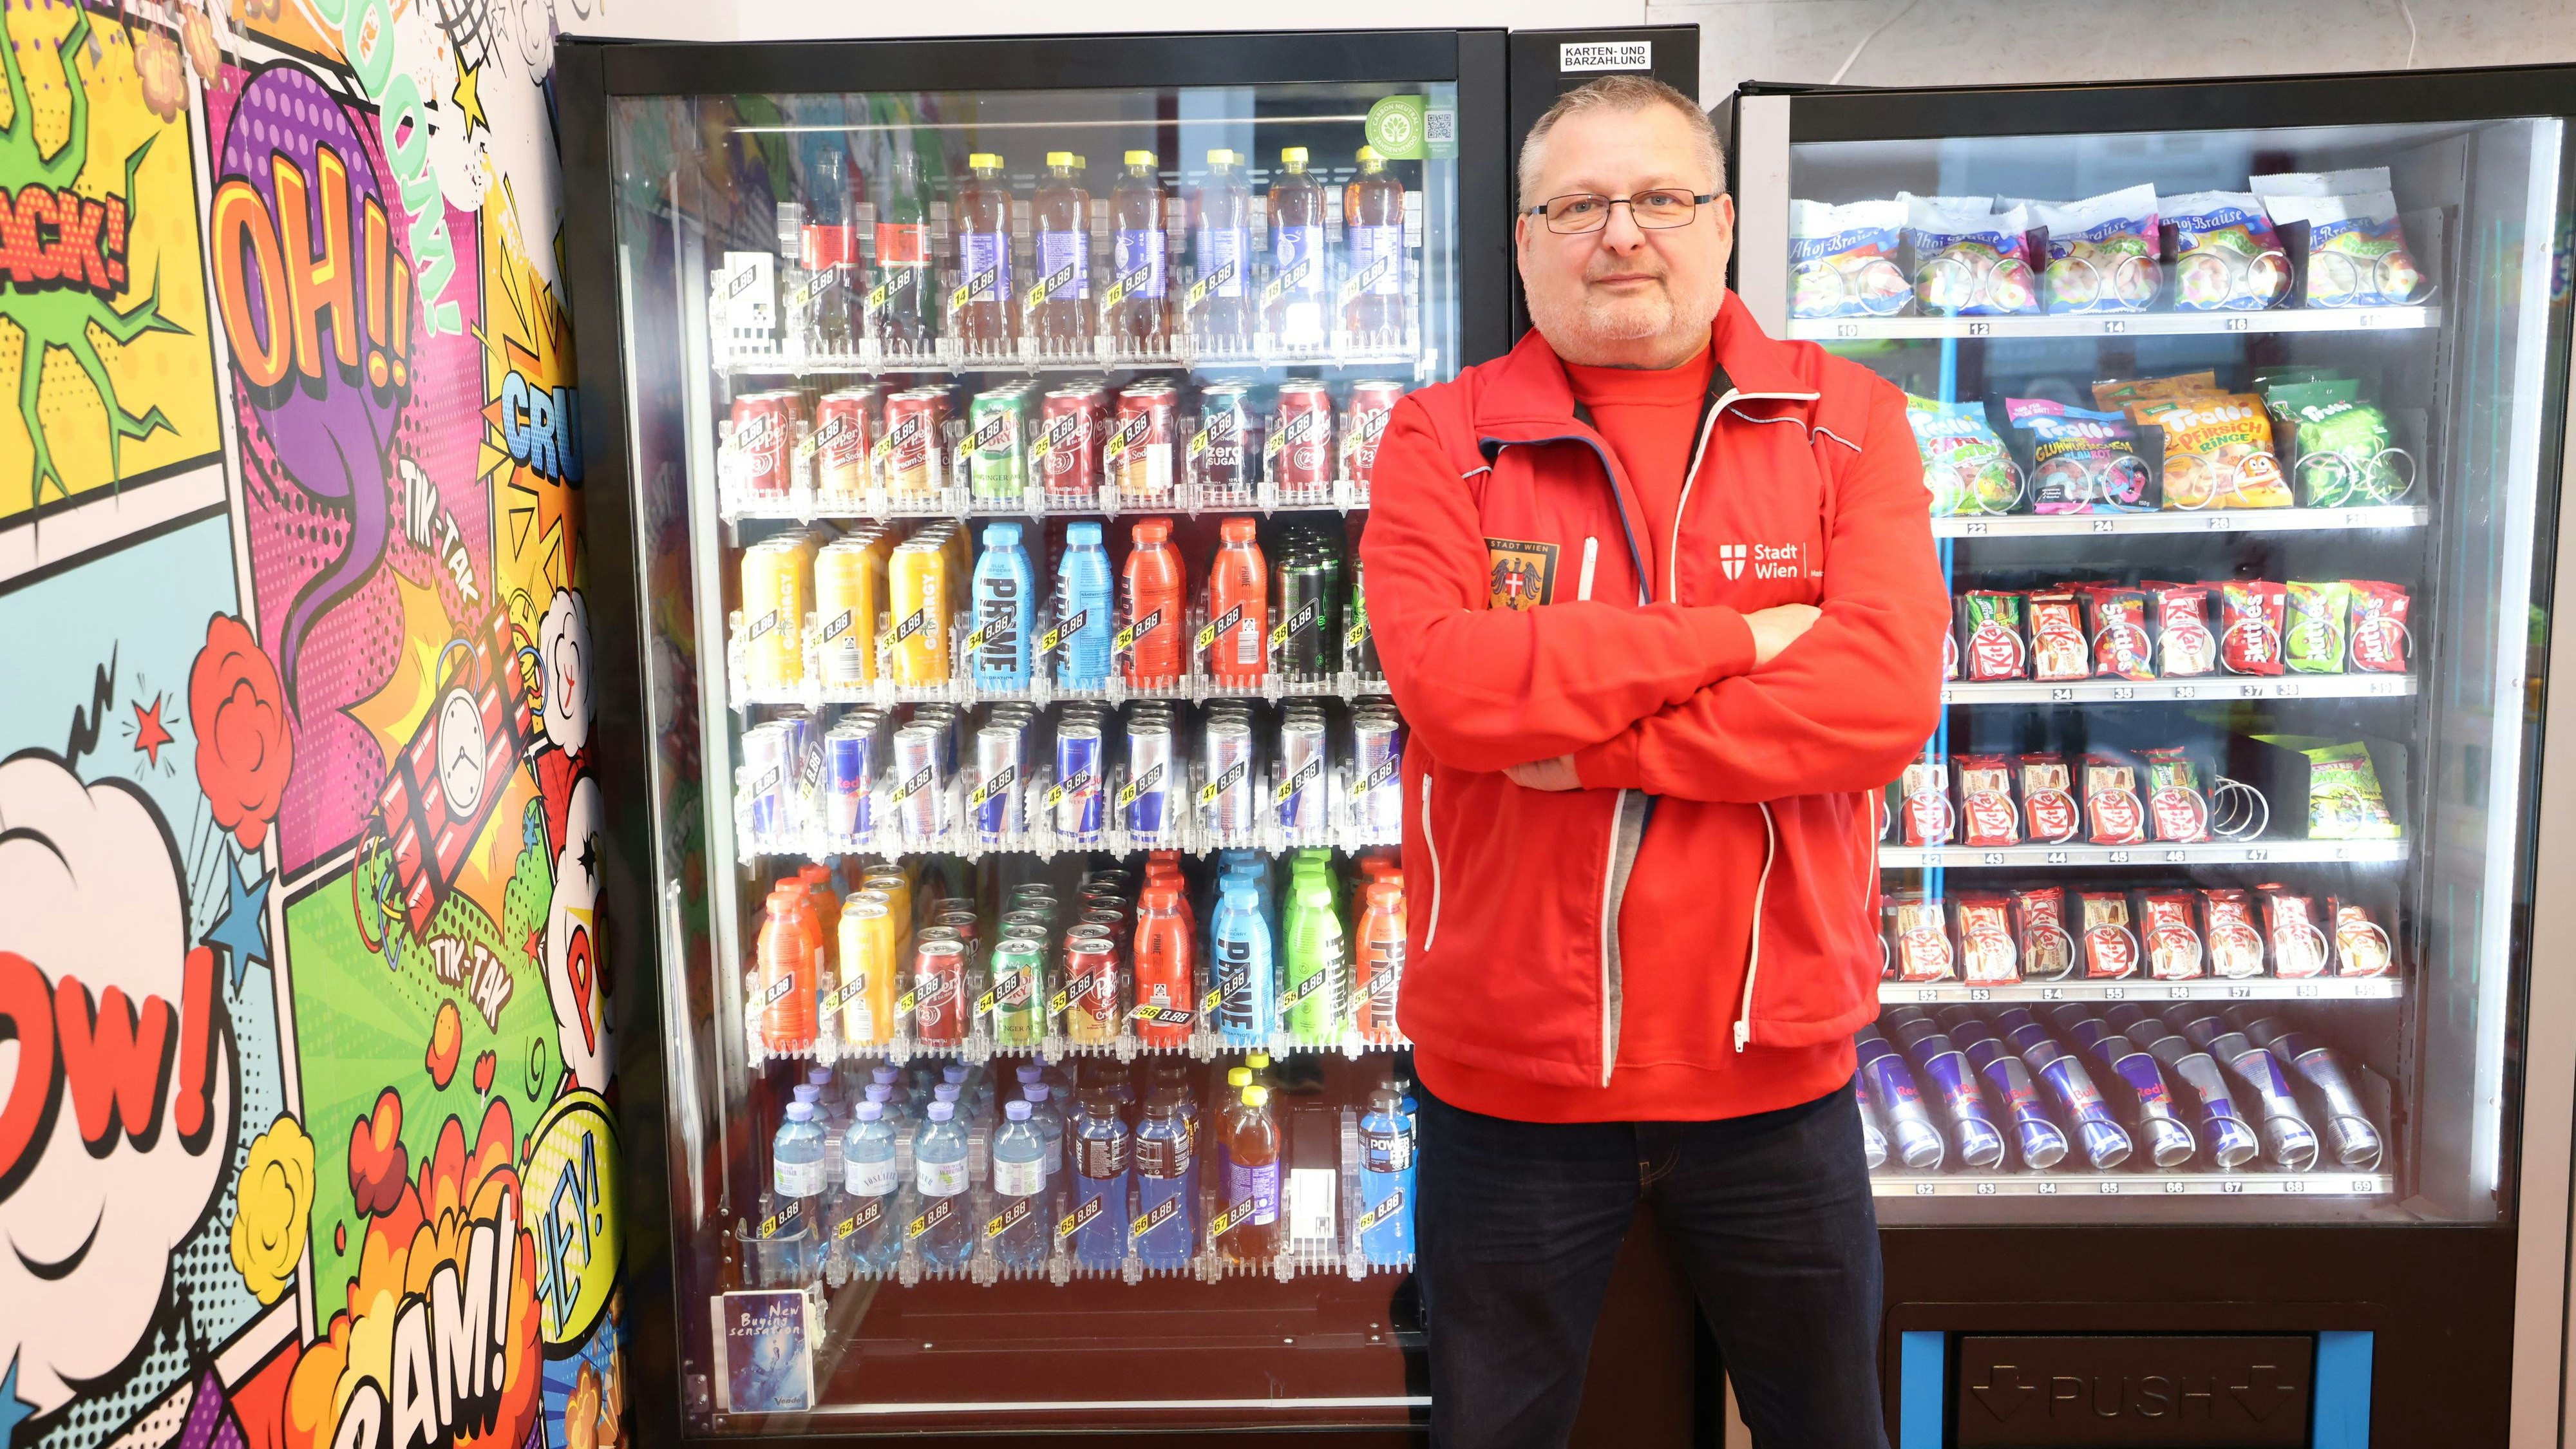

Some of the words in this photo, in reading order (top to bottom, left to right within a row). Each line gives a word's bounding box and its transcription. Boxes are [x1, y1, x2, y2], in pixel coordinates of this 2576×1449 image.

[1566, 48, 1617, 56] KARTEN-
[1621, 46, 1645, 55] UND
[1565, 56, 1645, 66] BARZAHLUNG
[1372, 104, 1394, 126] CARBON
[1395, 104, 1419, 125] NEUTRAL
[1374, 135, 1417, 153] SANDENVENDO
[212, 145, 410, 388] OH!!
[871, 290, 884, 305] 13
[888, 270, 911, 295] 8.88
[954, 290, 967, 305] 14
[972, 270, 994, 294] 8.88
[1031, 288, 1043, 302] 15
[1048, 268, 1071, 292] 8.88
[1108, 288, 1121, 303] 16
[1125, 267, 1148, 292] 8.88
[1839, 325, 1856, 336] 10
[1971, 324, 1988, 334] 12
[2107, 322, 2124, 332] 14
[2230, 320, 2246, 330] 16
[2159, 404, 2252, 432] Trolli
[1110, 438, 1122, 453] 26
[1126, 418, 1147, 440] 8.88
[1193, 435, 1206, 451] 27
[1210, 416, 1233, 439] 8.88
[2029, 417, 2114, 439] Trolli
[961, 440, 974, 455] 24
[978, 421, 999, 442] 8.88
[1036, 439, 1049, 454] 25
[1053, 422, 1075, 443] 8.88
[400, 460, 478, 603] TIK-TAK
[1968, 524, 1985, 534] 22
[2095, 522, 2112, 531] 24
[2211, 519, 2228, 529] 26
[1490, 540, 1521, 550] STADT
[1524, 544, 1548, 553] WIEN
[1754, 543, 1797, 560] Stadt
[1240, 566, 1251, 587] PRIME
[1755, 563, 1797, 579] Wien
[970, 634, 981, 649] 34
[986, 616, 1008, 638] 8.88
[1043, 631, 1056, 648] 35
[1061, 614, 1083, 636] 8.88
[1118, 630, 1130, 646] 36
[1136, 613, 1158, 636] 8.88
[1200, 630, 1213, 644] 37
[1218, 609, 1240, 631] 8.88
[1274, 627, 1287, 642] 38
[1291, 609, 1312, 632] 8.88
[1350, 627, 1363, 641] 39
[2101, 604, 2134, 672] Skittles
[2054, 690, 2071, 699] 34
[2115, 689, 2132, 698] 35
[2177, 688, 2193, 697] 36
[2245, 687, 2262, 696] 37
[973, 788, 986, 803] 44
[990, 769, 1011, 791] 8.88
[1122, 787, 1134, 801] 46
[1139, 768, 1160, 791] 8.88
[1986, 854, 2003, 864] 43
[2049, 853, 2066, 862] 44
[2110, 852, 2127, 862] 45
[2167, 851, 2184, 861] 46
[2249, 850, 2266, 860] 47
[2032, 909, 2059, 948] KitKat
[430, 938, 511, 1027] TIK-TAK
[1207, 993, 1220, 1007] 57
[1224, 974, 1245, 994] 8.88
[1285, 992, 1296, 1007] 58
[1301, 972, 1323, 995] 8.88
[901, 996, 913, 1010] 53
[918, 978, 938, 999] 8.88
[980, 995, 992, 1009] 54
[997, 977, 1018, 998] 8.88
[1053, 994, 1065, 1008] 55
[1069, 976, 1090, 998] 8.88
[1920, 990, 1937, 1000] 52
[1972, 990, 1989, 999] 53
[2044, 990, 2063, 999] 54
[2107, 989, 2123, 998] 55
[2172, 988, 2188, 998] 56
[2232, 987, 2249, 997] 57
[2298, 987, 2316, 996] 58
[1142, 1007, 1157, 1017] 56
[1159, 1010, 1186, 1022] 8.88
[1917, 1184, 1933, 1194] 62
[1978, 1184, 1994, 1193] 63
[2040, 1184, 2056, 1193] 64
[2101, 1184, 2118, 1193] 65
[2166, 1183, 2183, 1192] 66
[2225, 1182, 2242, 1192] 67
[2287, 1182, 2303, 1191] 68
[2354, 1181, 2371, 1191] 69
[764, 1221, 775, 1235] 61
[779, 1202, 799, 1224] 8.88
[840, 1222, 852, 1235] 62
[857, 1204, 877, 1225] 8.88
[911, 1220, 923, 1235] 63
[928, 1202, 948, 1223] 8.88
[989, 1219, 1001, 1234] 64
[1006, 1202, 1026, 1223] 8.88
[1061, 1217, 1074, 1231] 65
[1077, 1200, 1098, 1223] 8.88
[1135, 1218, 1148, 1232] 66
[1151, 1201, 1171, 1223] 8.88
[1214, 1217, 1226, 1231] 67
[1231, 1199, 1251, 1222] 8.88
[769, 1300, 799, 1317] New
[741, 1313, 788, 1329] Buying
[729, 1325, 799, 1336] sensation
[2050, 1376, 2216, 1417] PUSH
